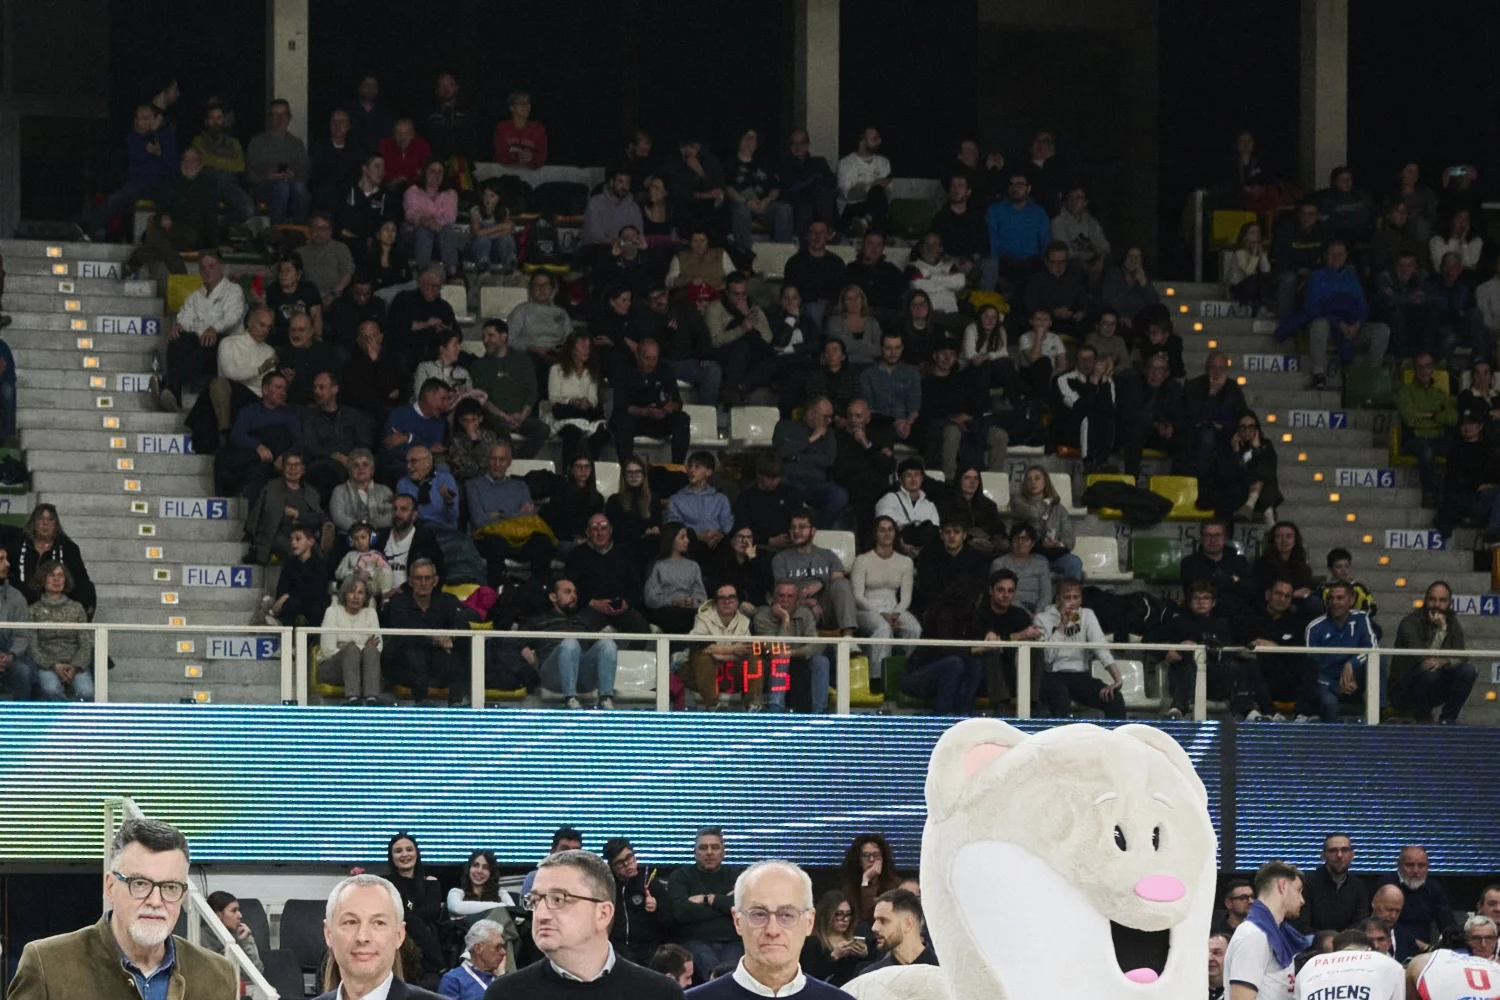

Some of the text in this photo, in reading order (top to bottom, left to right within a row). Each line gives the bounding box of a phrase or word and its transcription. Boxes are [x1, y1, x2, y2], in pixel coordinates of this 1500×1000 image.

[82, 264, 118, 278] FILA
[102, 318, 156, 334] FILA 8
[1248, 357, 1297, 371] FILA 8
[122, 376, 151, 392] FIL
[1293, 412, 1344, 428] FILA 7
[143, 436, 180, 453] FILA
[1340, 470, 1391, 487] FILA 6
[165, 501, 223, 518] FILA 5
[1390, 532, 1442, 549] FILA 5
[188, 569, 247, 586] FILA 4
[1483, 598, 1494, 614] 4
[212, 640, 274, 658] FILA 3
[1314, 953, 1372, 967] PATRIKIS
